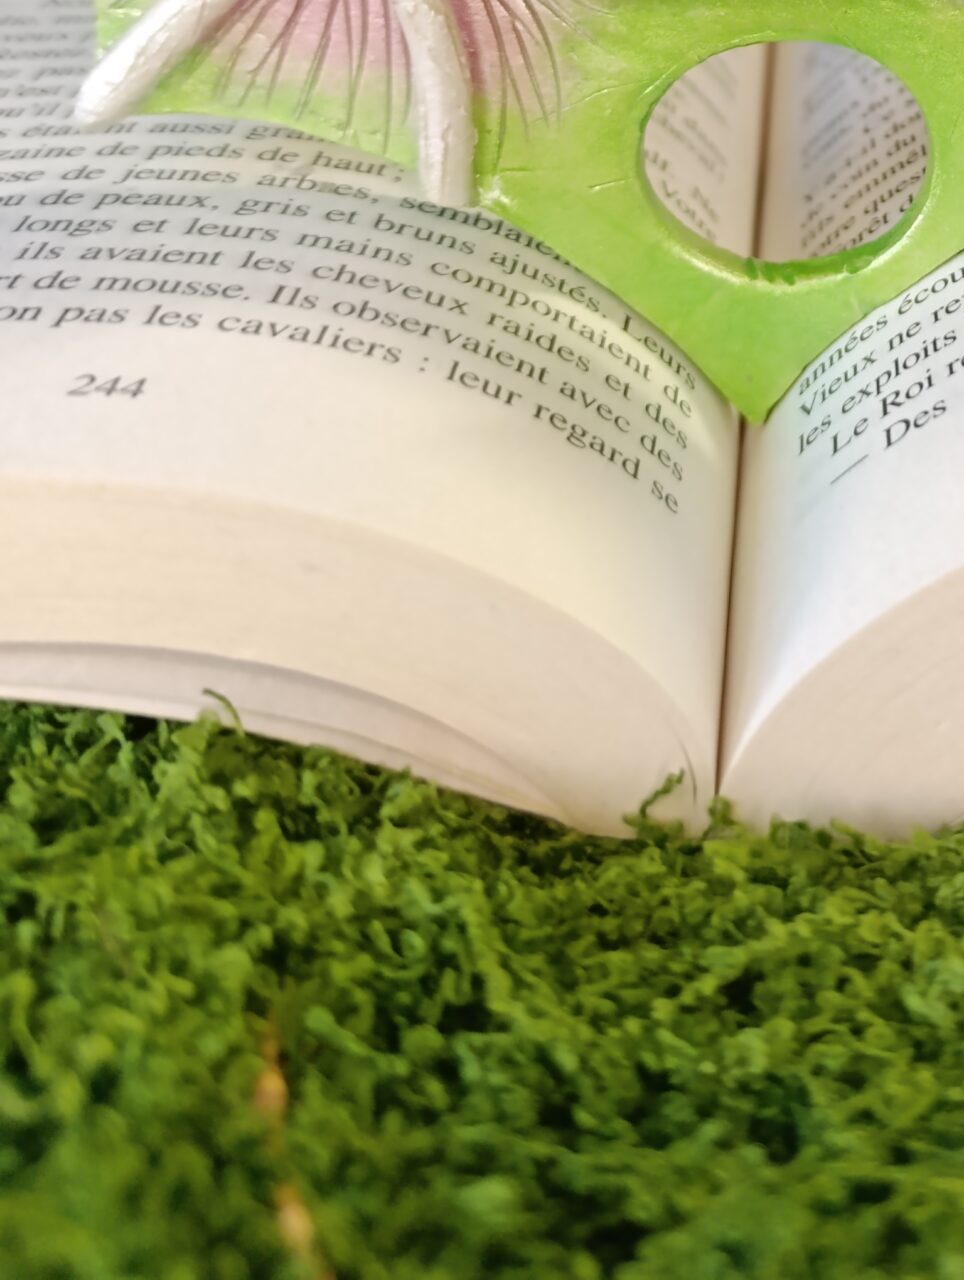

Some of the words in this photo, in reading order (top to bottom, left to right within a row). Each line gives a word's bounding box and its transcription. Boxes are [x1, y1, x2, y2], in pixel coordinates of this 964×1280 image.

[96, 141, 140, 157] de
[145, 141, 244, 161] pieds
[256, 145, 300, 163] de
[148, 120, 236, 136] aussi
[61, 165, 106, 182] de
[112, 163, 239, 185] jeunes
[257, 173, 380, 204] arbes,
[11, 214, 118, 237] longs
[131, 216, 169, 233] et
[184, 217, 281, 242] leurs
[296, 232, 414, 267] mains
[429, 260, 652, 382] comportaient
[663, 382, 694, 419] de
[39, 188, 85, 206] de
[92, 191, 220, 211] peaux,
[233, 197, 312, 217] gris
[325, 207, 362, 225] et
[373, 212, 477, 256] bruns
[489, 249, 608, 318] ajustés.
[621, 312, 698, 391] Leurs
[14, 240, 66, 261] ils
[79, 243, 224, 267] avaient
[238, 251, 296, 275] les
[311, 263, 470, 317] cheveux
[486, 311, 591, 373] raides
[604, 371, 633, 402] et
[644, 400, 689, 450] des
[32, 269, 82, 291] de
[90, 275, 251, 301] mousse.
[266, 284, 320, 311] Ils
[331, 299, 551, 386] observaient
[558, 379, 632, 434] avec
[640, 432, 684, 482] des
[66, 372, 148, 399] 244
[797, 412, 833, 457] les
[840, 327, 958, 417] exploits
[799, 314, 890, 397] années
[800, 350, 878, 417] Vieux
[886, 320, 923, 355] ne
[50, 305, 131, 329] pas
[141, 303, 204, 329] les
[216, 313, 403, 365] cavaliers
[445, 359, 523, 407] leur
[532, 402, 642, 481] regard
[650, 478, 680, 515] se
[831, 416, 870, 458] Le
[880, 366, 936, 419] Roi
[884, 398, 948, 451] Des
